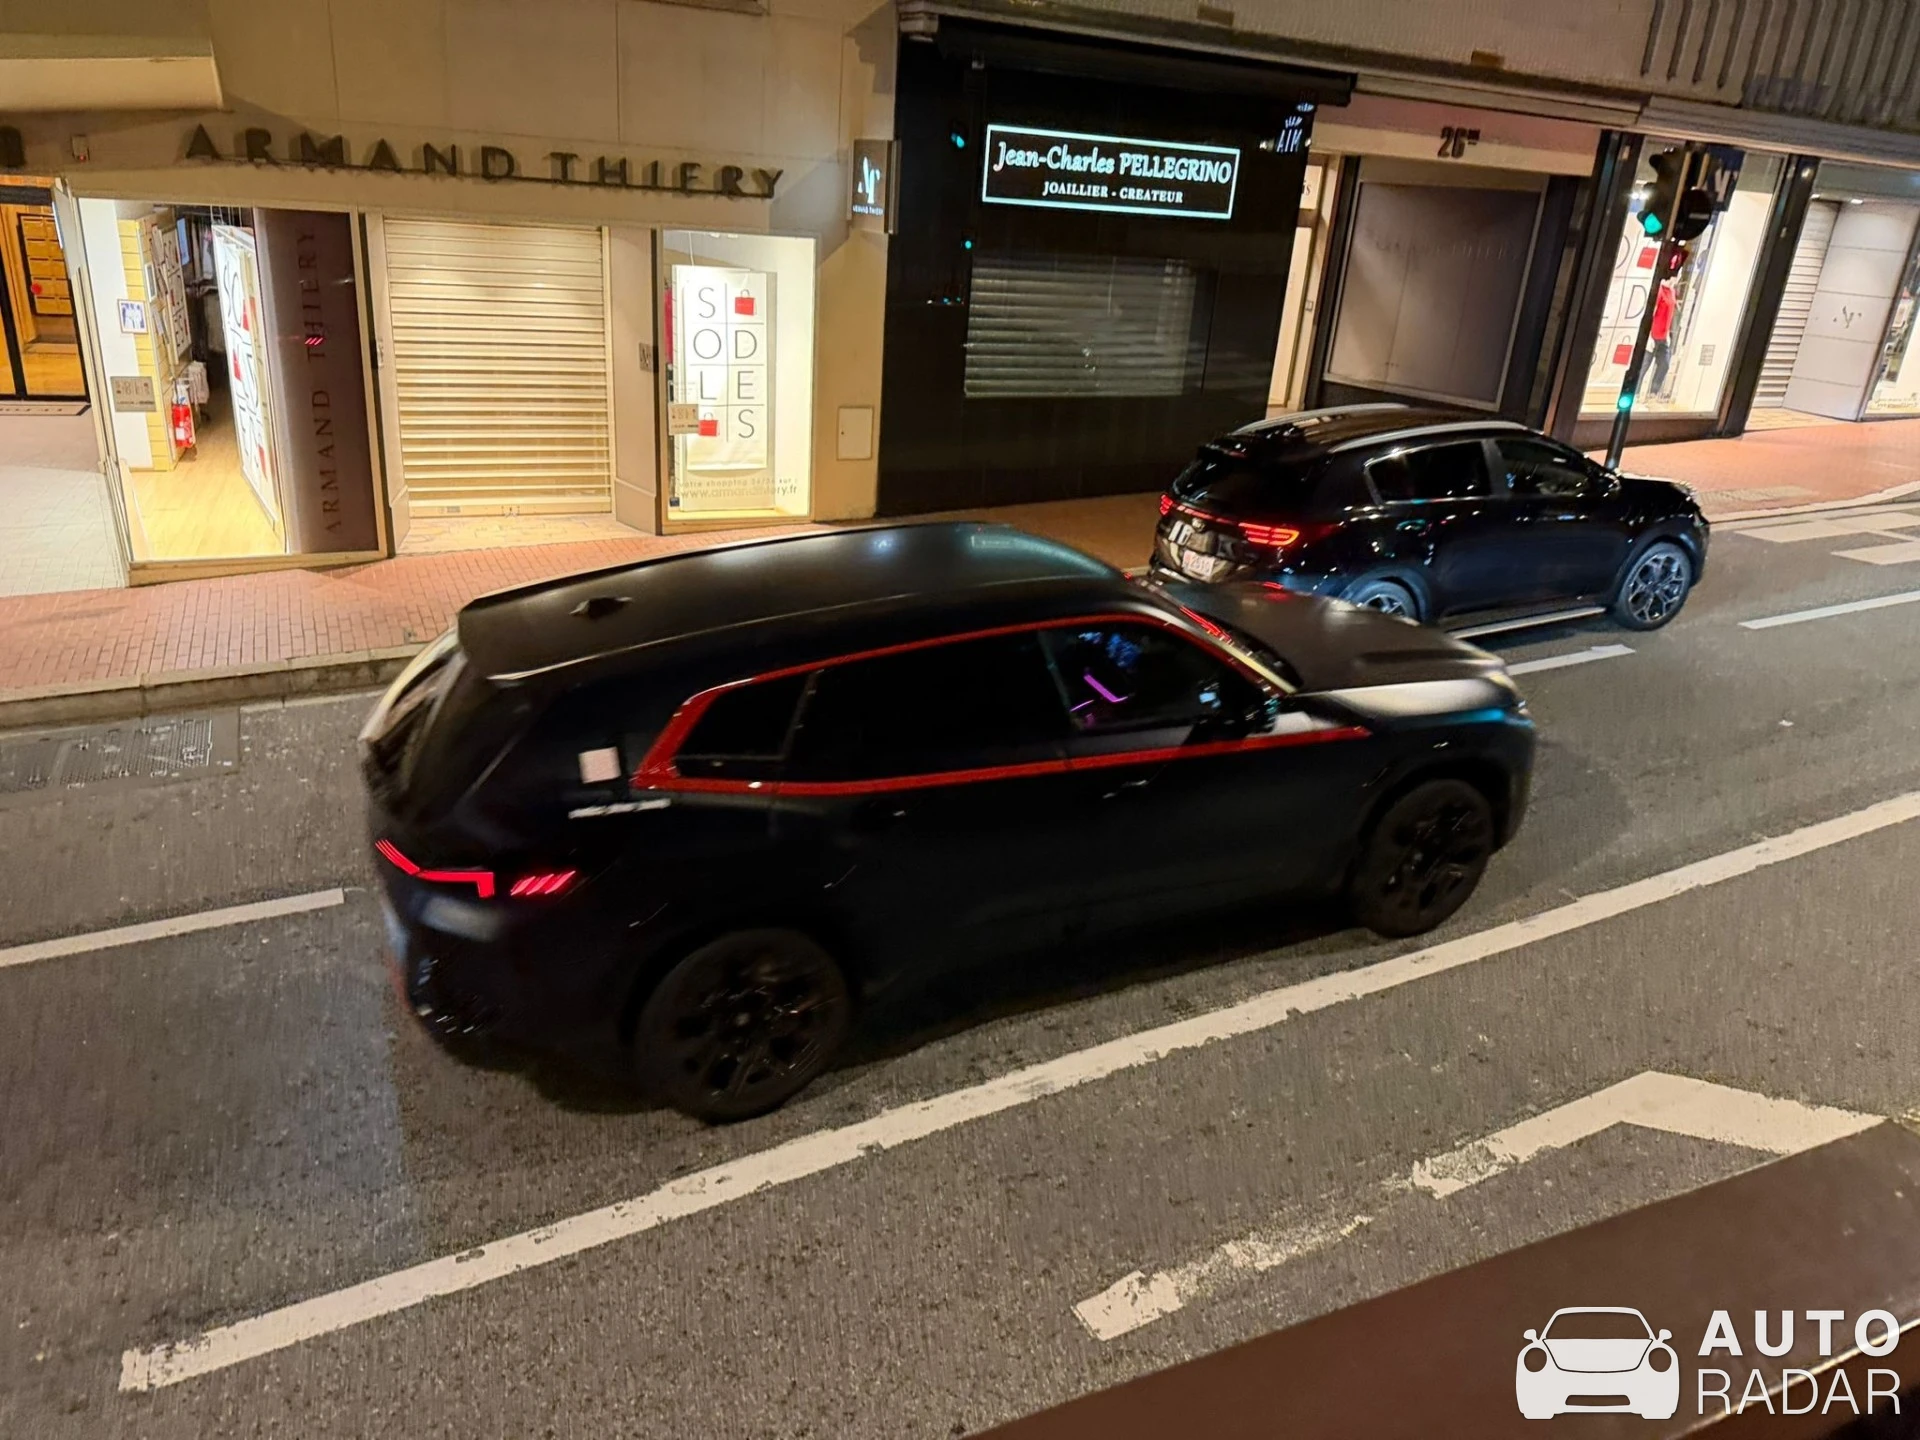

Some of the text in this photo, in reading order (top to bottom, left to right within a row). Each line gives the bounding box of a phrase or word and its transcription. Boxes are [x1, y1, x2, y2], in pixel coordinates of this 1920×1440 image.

[185, 123, 784, 198] ARMAND THIERY
[993, 140, 1232, 184] Jean-Charles PELLEGRINO
[1042, 181, 1183, 203] JOAILLIER CREATEUR
[297, 229, 342, 533] ARMAND THIERY
